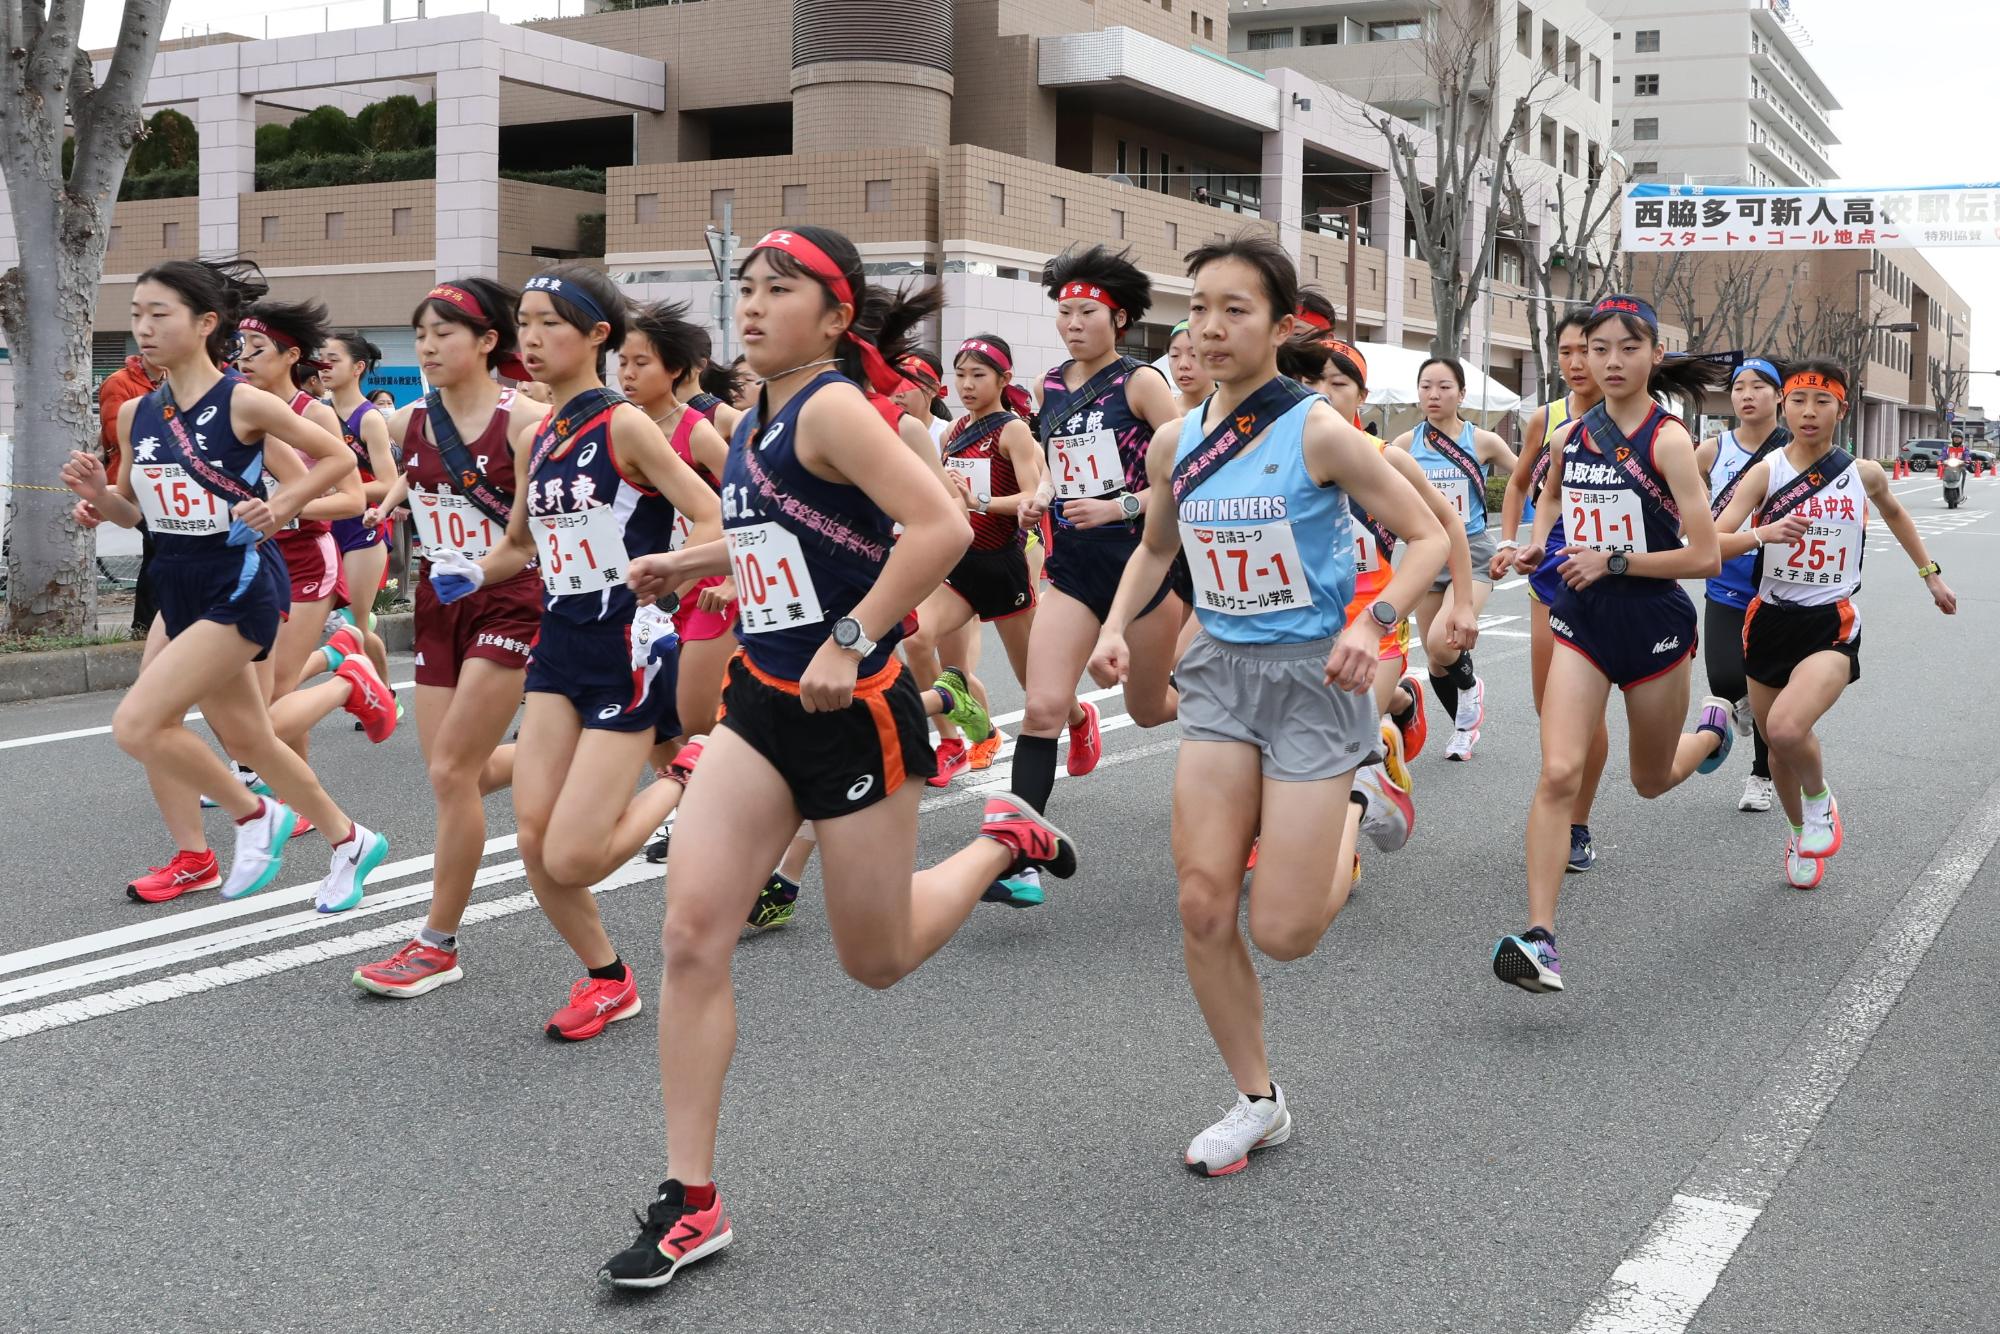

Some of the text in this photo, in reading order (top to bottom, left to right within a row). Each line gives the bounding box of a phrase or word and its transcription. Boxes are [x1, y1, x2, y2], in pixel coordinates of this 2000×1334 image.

[1635, 193, 2000, 228] 西脇多可新人高校駅伝
[1053, 410, 1105, 435] 学館
[1065, 435, 1096, 449] 日清ヨーク
[1058, 451, 1099, 482] 2-1
[154, 482, 216, 518] 15-1
[1218, 496, 1288, 521] NEVERS
[1583, 493, 1619, 504] 日清ヨーク
[430, 510, 492, 548] 10-1
[1216, 530, 1263, 545] 日清ヨーク
[1572, 506, 1633, 542] 21-1
[548, 533, 597, 574] 3-1
[1787, 539, 1847, 572] 25-1
[1206, 549, 1290, 592] 17-1
[1773, 567, 1842, 584] 女子混合B
